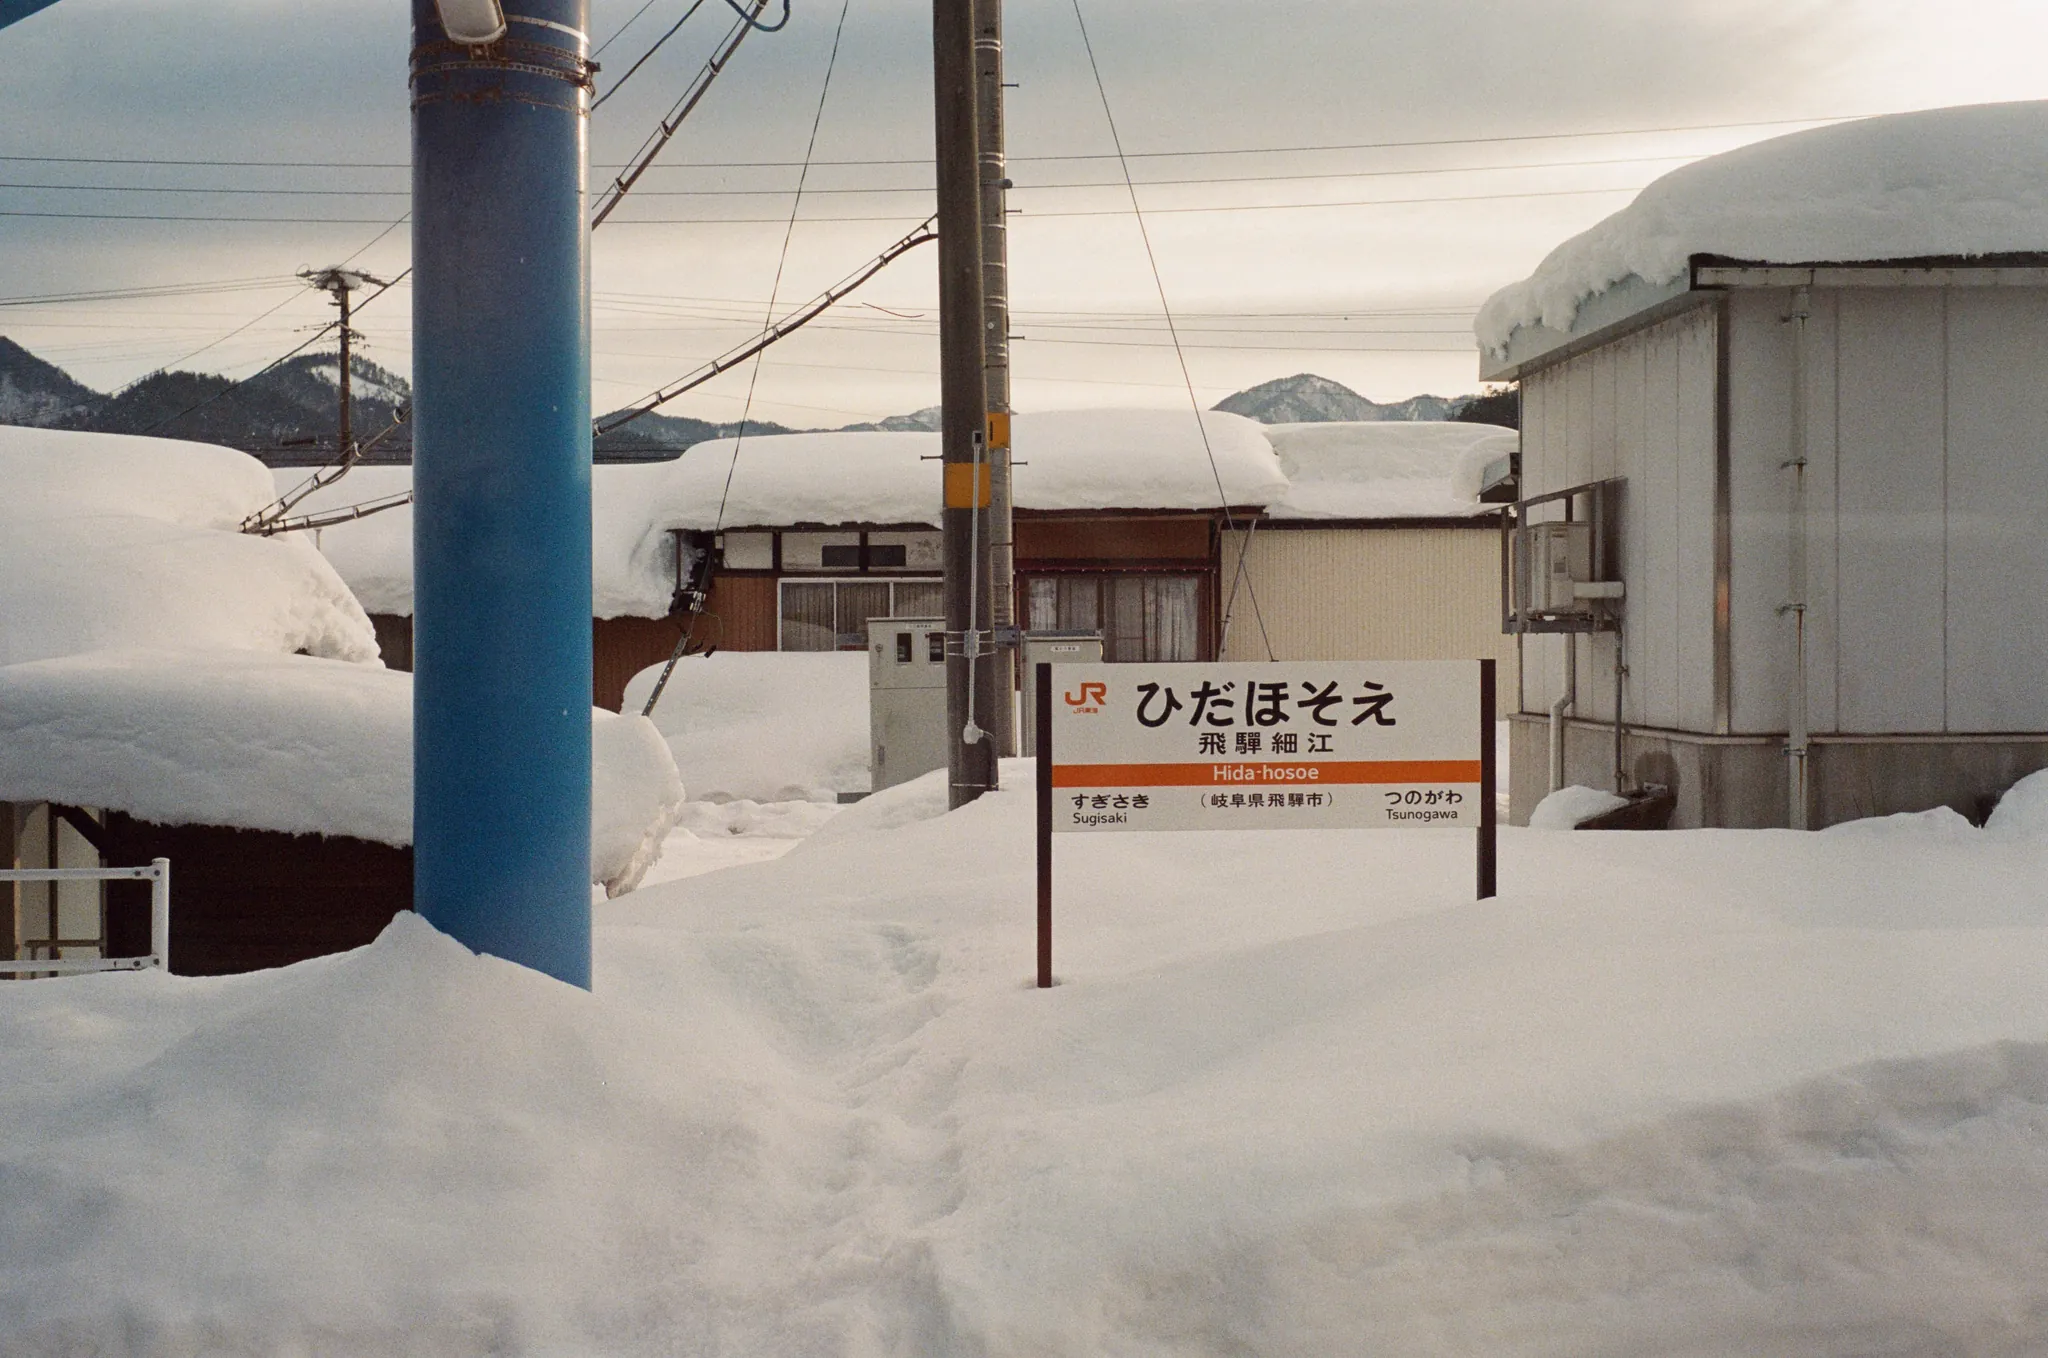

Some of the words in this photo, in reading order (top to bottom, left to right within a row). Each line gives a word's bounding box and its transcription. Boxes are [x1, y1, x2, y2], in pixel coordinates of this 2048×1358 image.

[1064, 681, 1107, 706] JR
[1136, 680, 1397, 728] ひだほそえ
[1213, 764, 1319, 781] Hida-hosoe
[1070, 793, 1150, 810] すぎさき
[1384, 789, 1463, 806] つのがわ
[1072, 812, 1128, 827] Sugisaki
[1385, 808, 1459, 823] Tsunogawa
